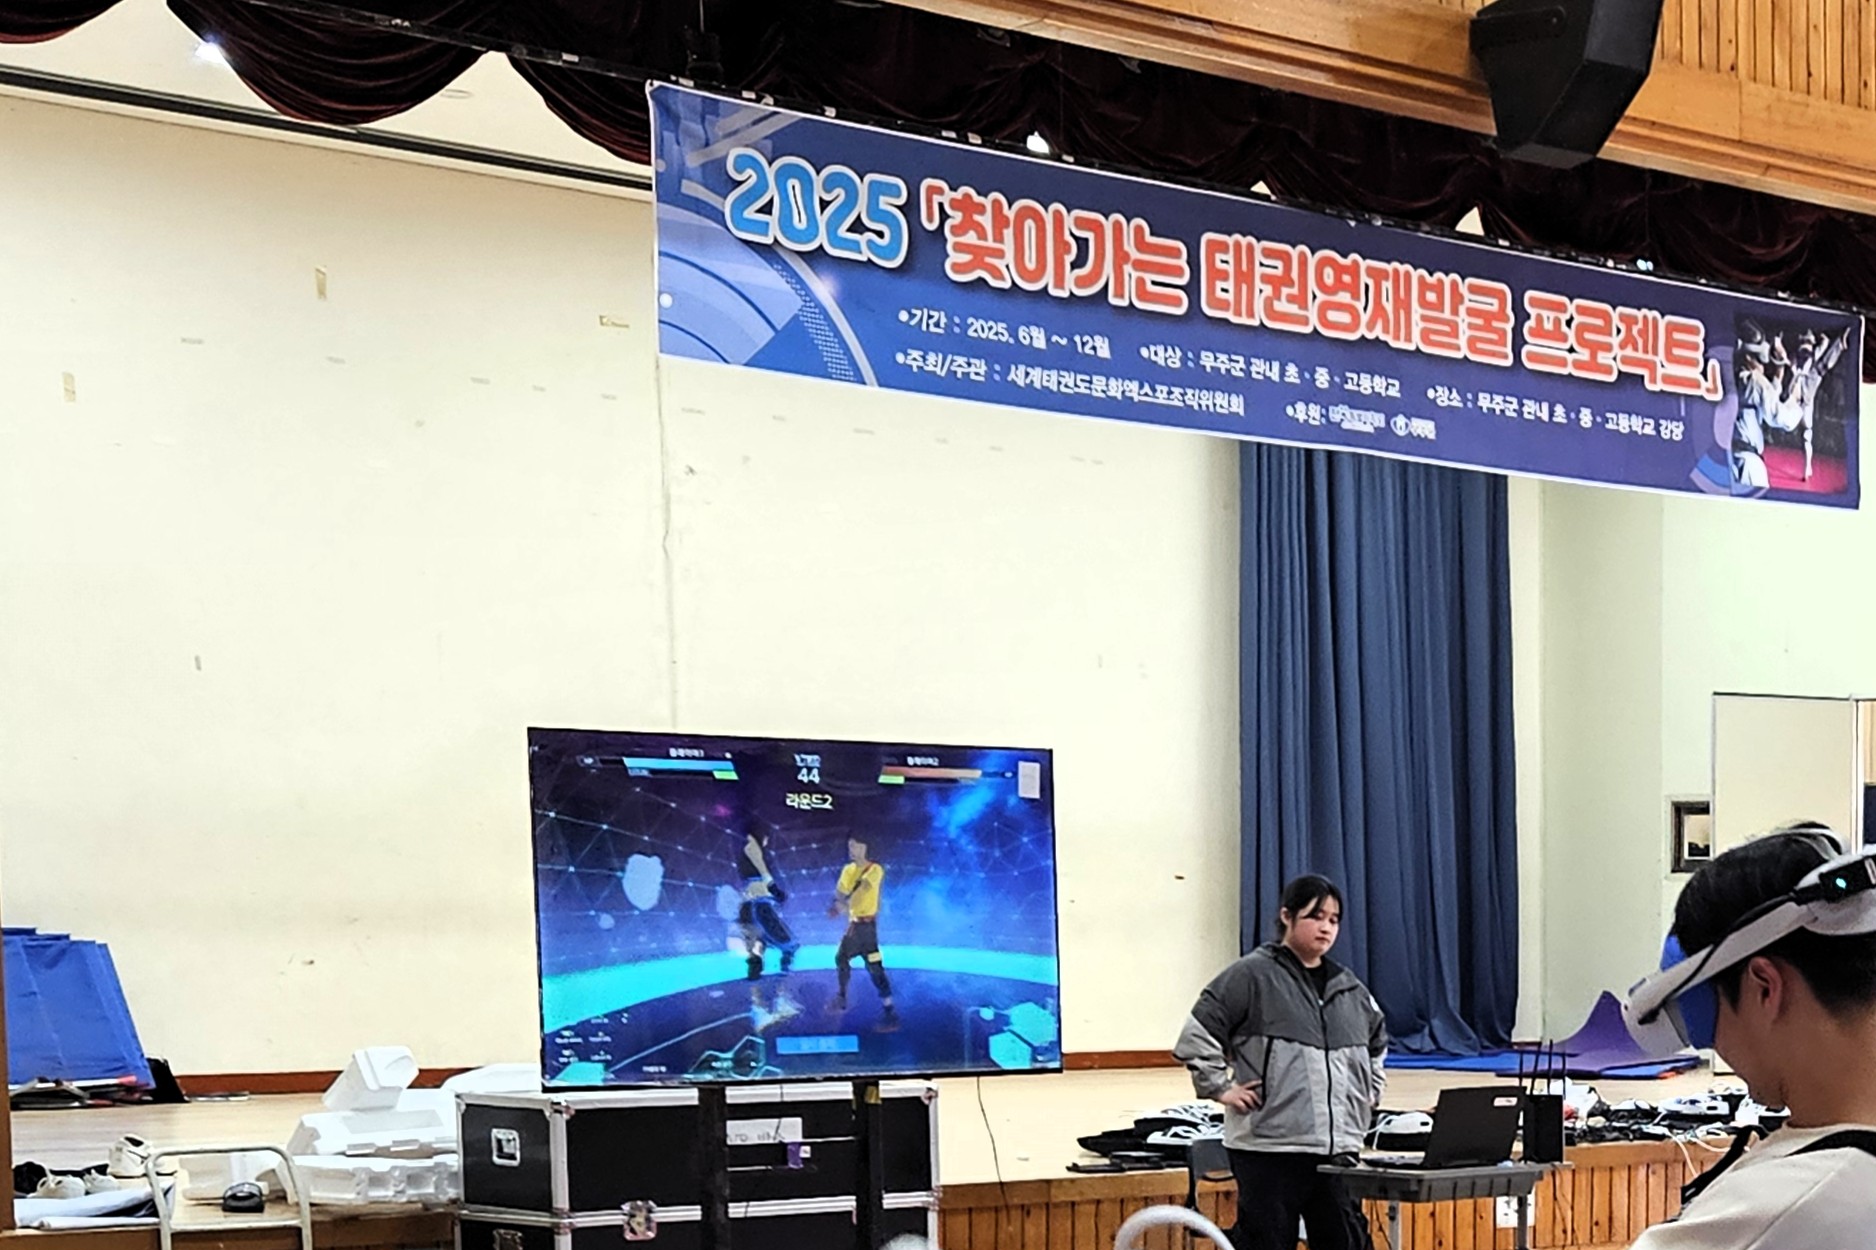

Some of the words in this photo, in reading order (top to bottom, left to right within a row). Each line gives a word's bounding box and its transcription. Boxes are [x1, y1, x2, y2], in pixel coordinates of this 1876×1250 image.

[726, 147, 907, 269] 2025
[1201, 230, 1515, 367] 태권영재발굴
[909, 308, 947, 334] 기간
[967, 317, 1015, 344] 2025.
[1018, 325, 1047, 350] 6월
[1074, 334, 1111, 359] 12월
[905, 349, 988, 381] 주최/주관
[1007, 364, 1244, 416] 세계태권도문화엑스포조직위원회
[1149, 344, 1182, 369] 대상
[1199, 350, 1246, 377] 무주군
[1250, 357, 1280, 382] 관내
[1284, 362, 1300, 384] 초
[1314, 366, 1330, 388] 중
[1343, 371, 1401, 398] 고등학교
[1435, 385, 1463, 409] 장소
[1477, 391, 1519, 417] 무주군
[1522, 399, 1549, 423] 관내
[1553, 404, 1567, 424] 초
[1578, 407, 1593, 429] 중
[1605, 412, 1657, 437] 고등학교
[785, 793, 834, 810] 라운드2
[797, 767, 820, 784] 44
